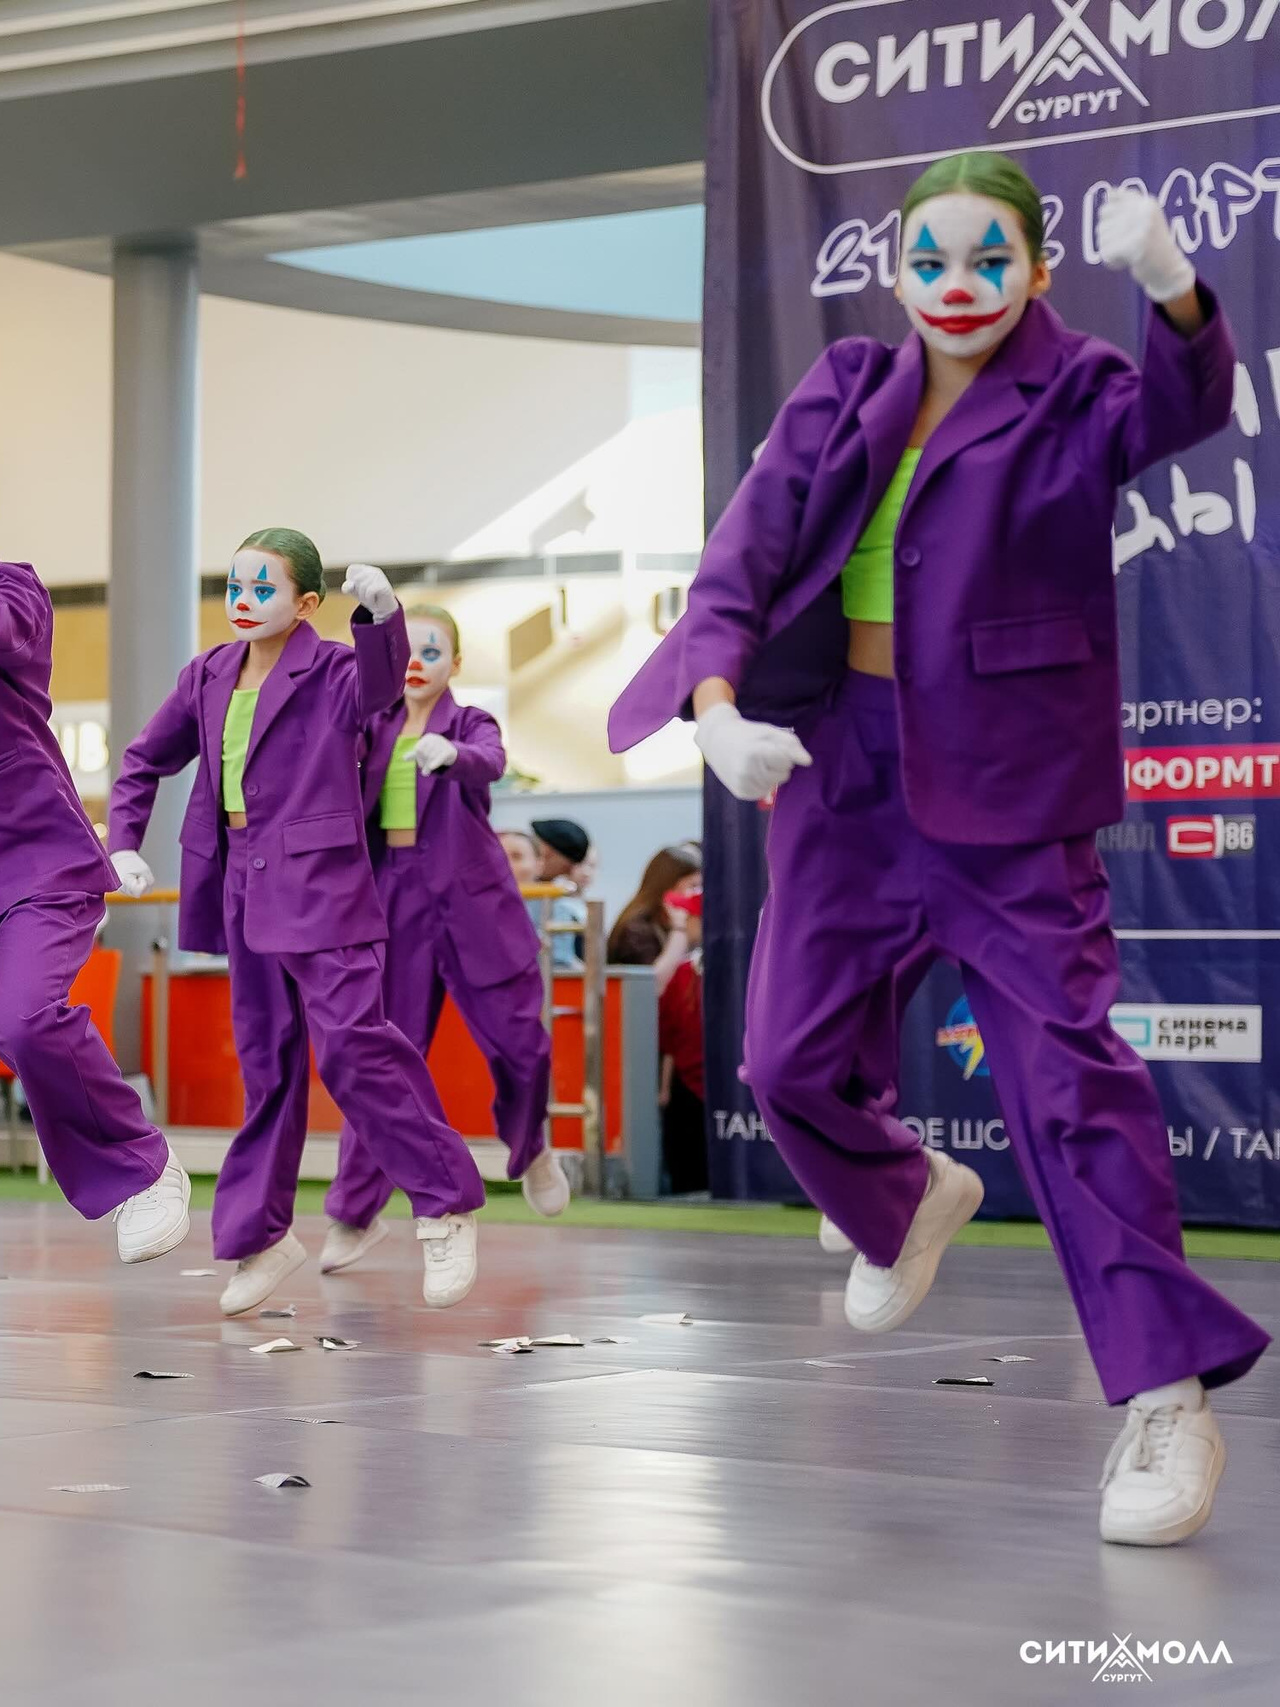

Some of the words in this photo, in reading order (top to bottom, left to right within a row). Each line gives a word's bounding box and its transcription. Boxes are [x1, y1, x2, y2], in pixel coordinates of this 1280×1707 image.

[814, 12, 1034, 104] СИТИ
[1015, 87, 1123, 125] СУРГУТ
[1121, 697, 1263, 734] артнер:
[1124, 754, 1280, 791] ФОРМТ
[1158, 1018, 1248, 1033] синема
[1158, 1035, 1216, 1053] парк
